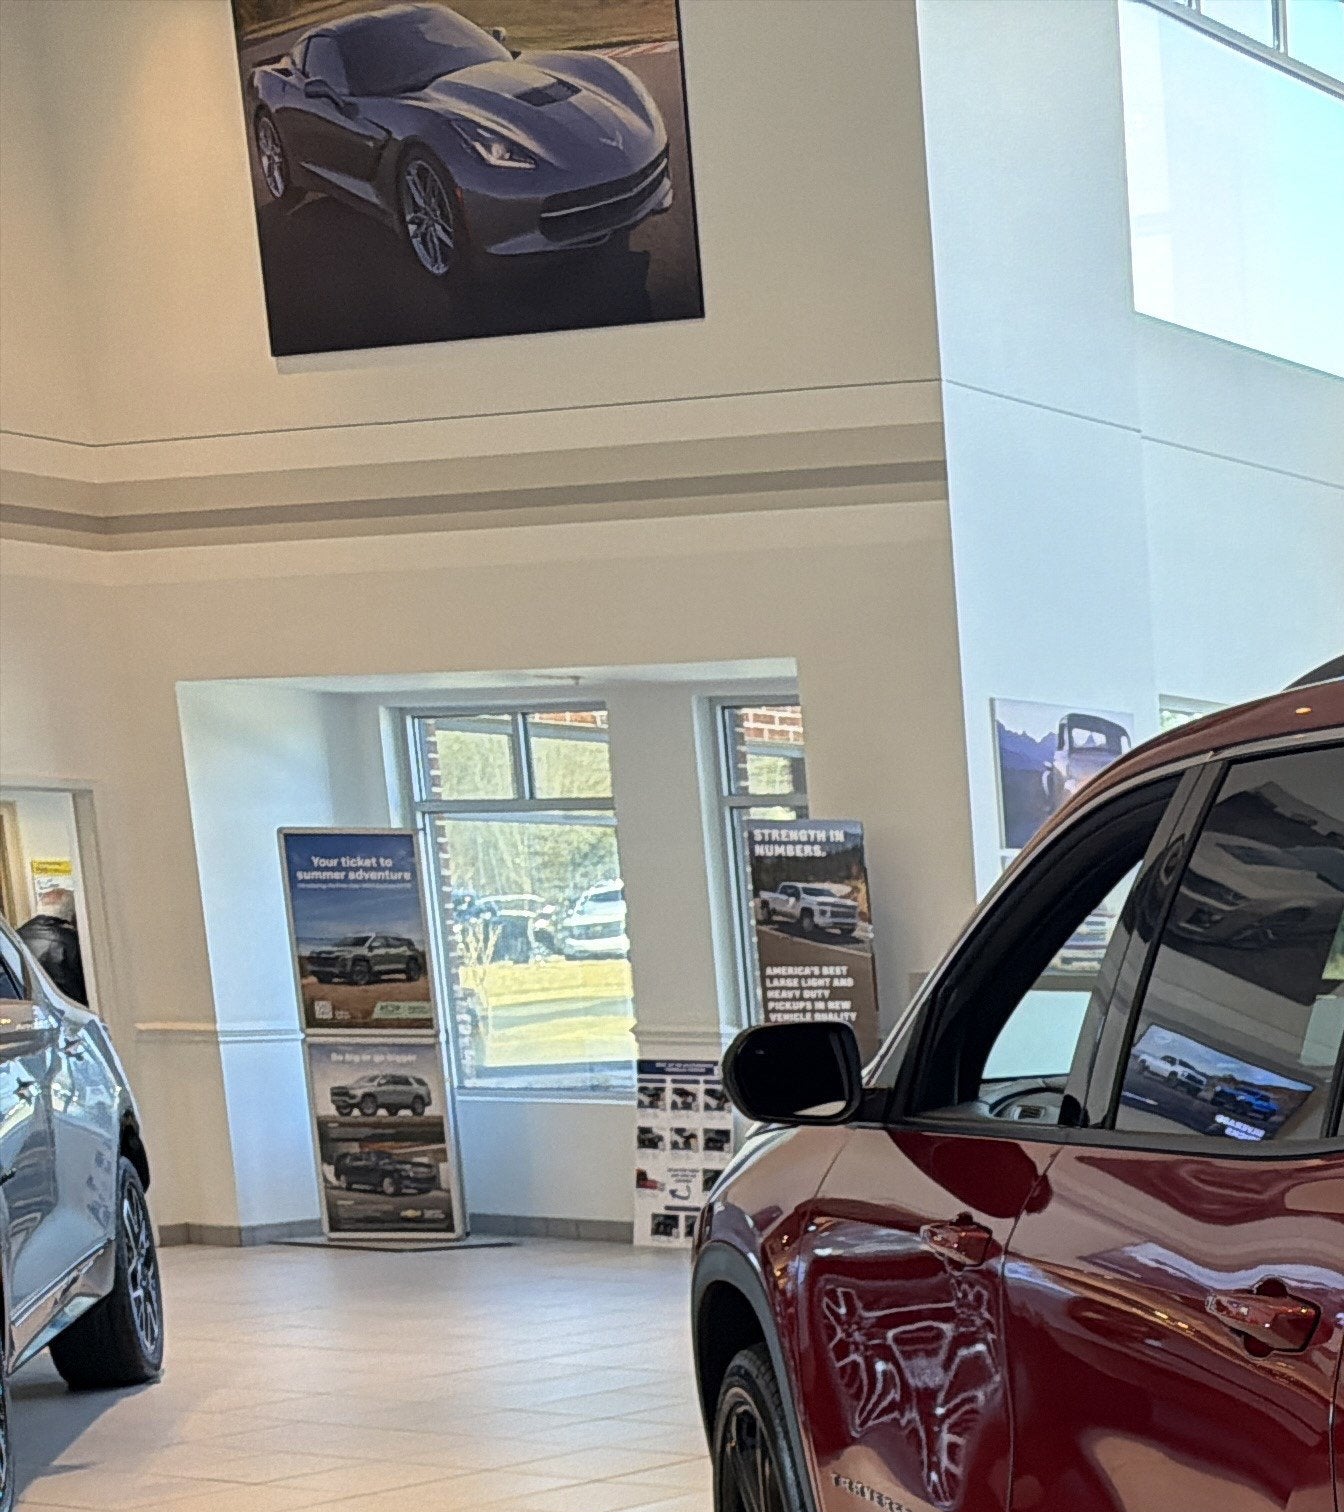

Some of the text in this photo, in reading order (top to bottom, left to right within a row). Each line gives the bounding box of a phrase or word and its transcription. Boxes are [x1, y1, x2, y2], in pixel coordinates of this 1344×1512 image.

[311, 856, 393, 867] Your ticket to
[296, 868, 411, 880] summer adventure
